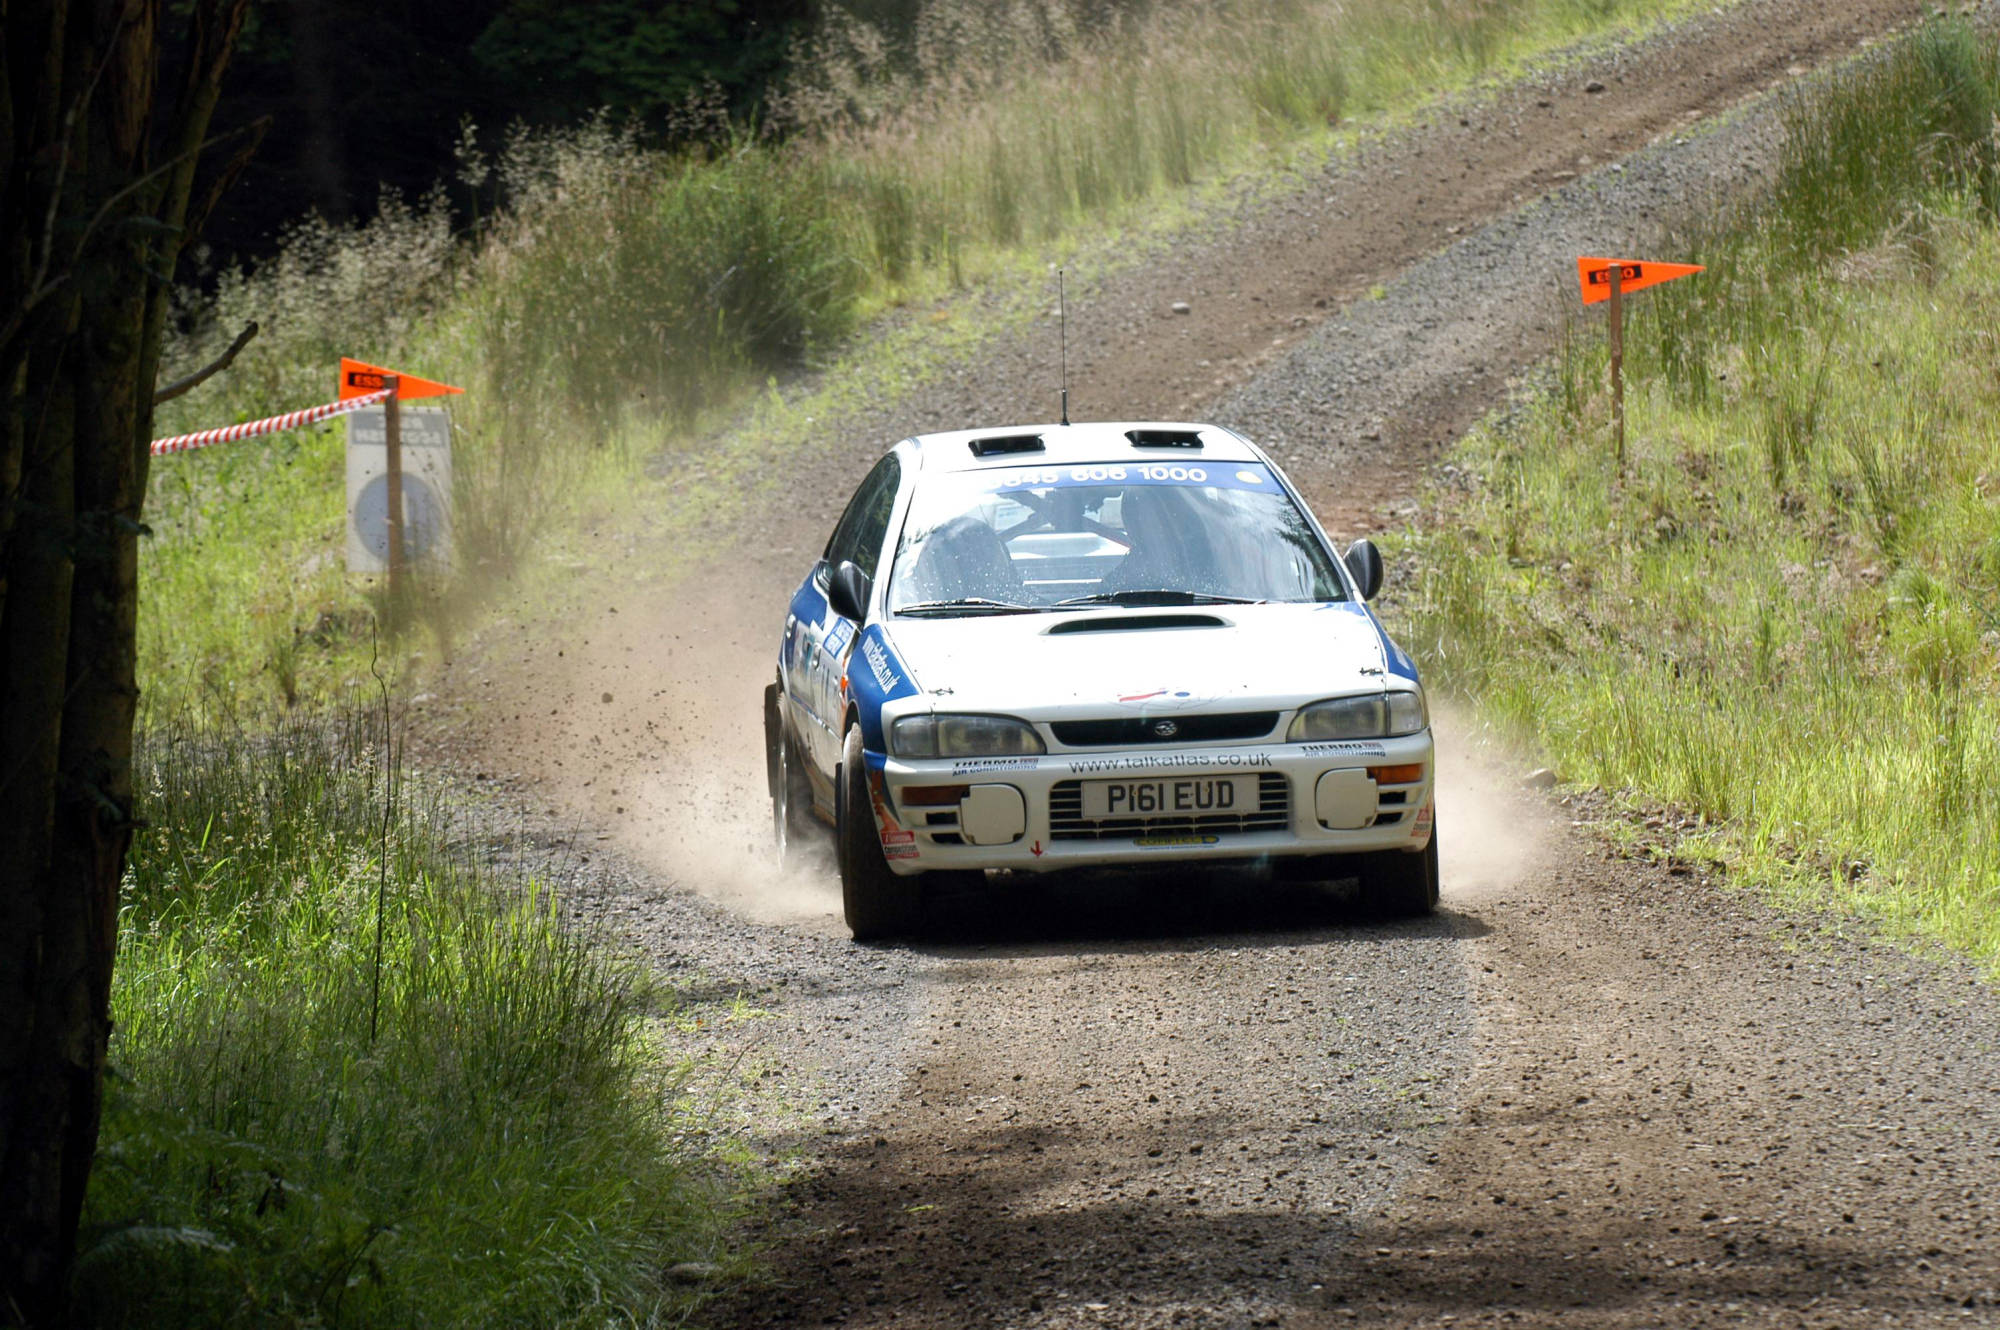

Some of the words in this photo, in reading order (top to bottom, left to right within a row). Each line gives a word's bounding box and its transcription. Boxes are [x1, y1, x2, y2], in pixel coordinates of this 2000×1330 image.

[1137, 466, 1208, 483] 1000
[953, 757, 1018, 768] THERMO
[1068, 752, 1273, 774] www.talkatlas.co.uk
[1174, 780, 1235, 811] EUD
